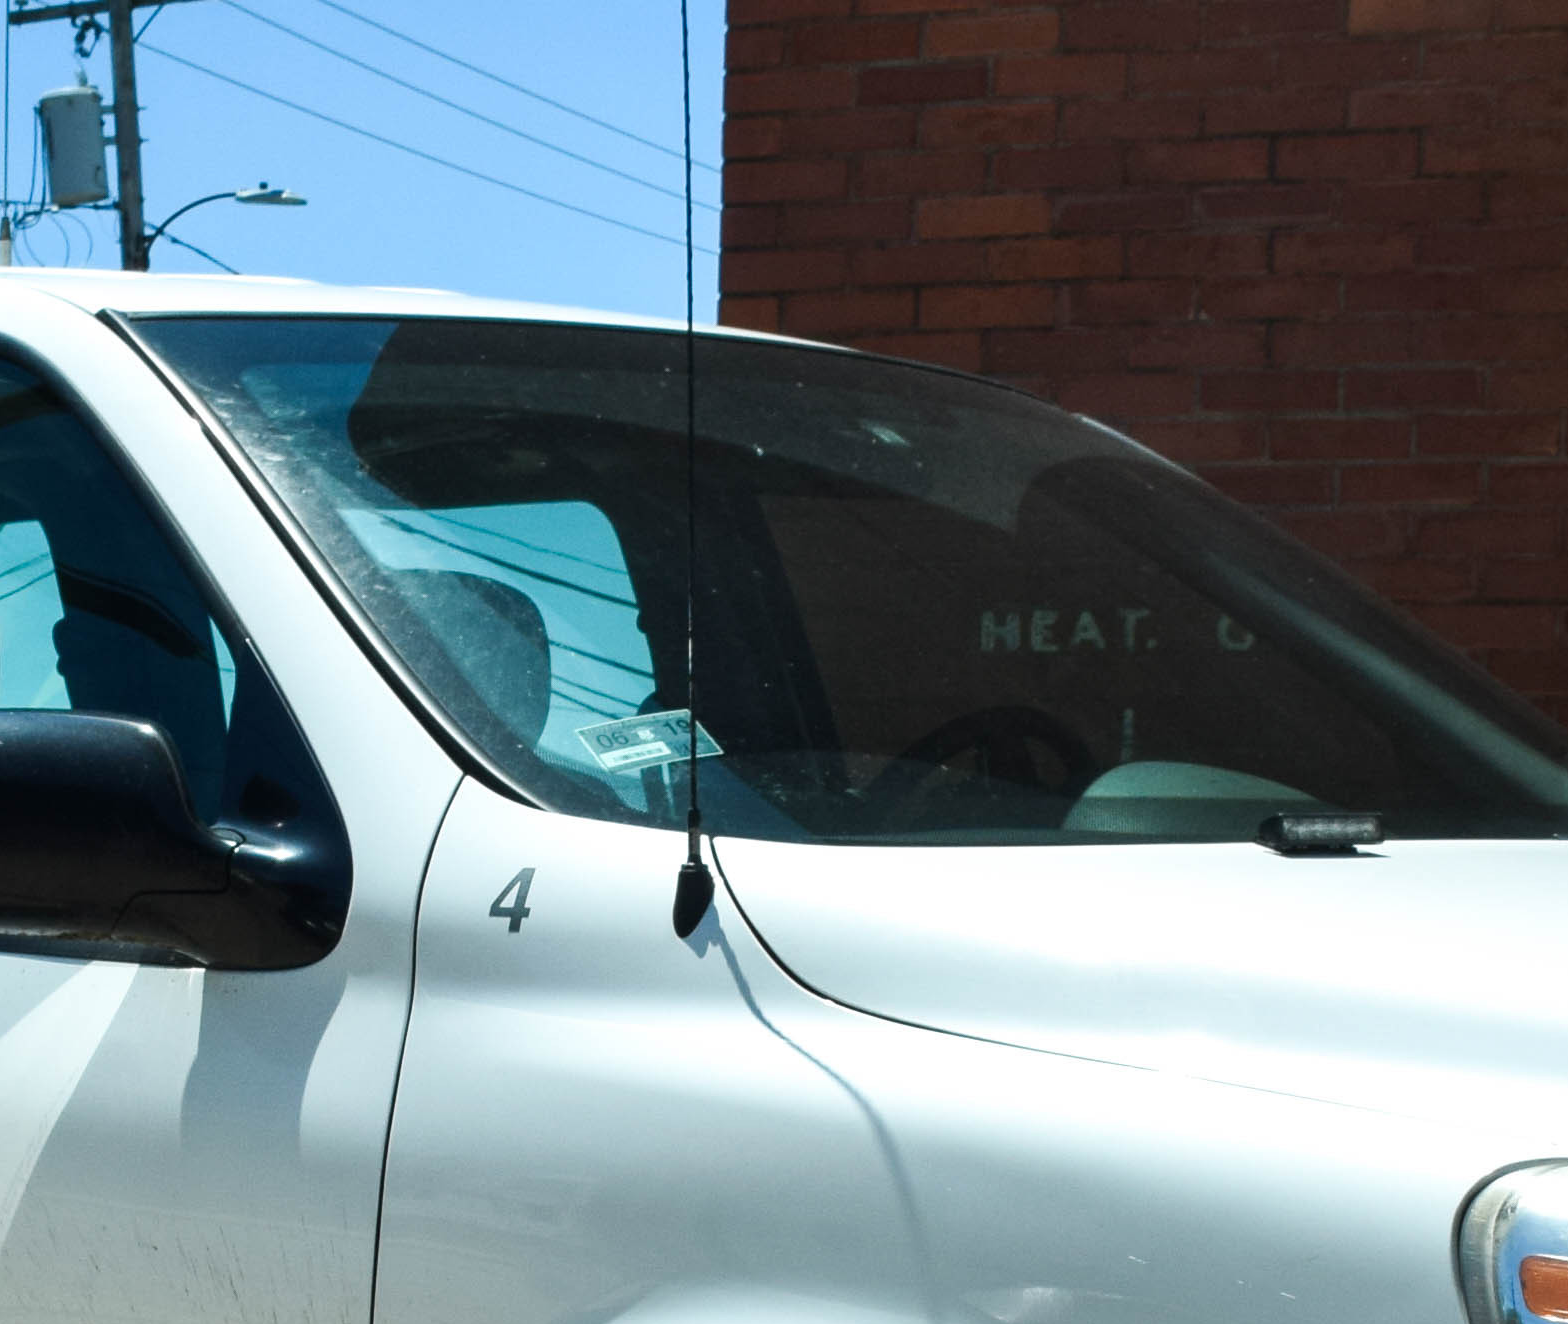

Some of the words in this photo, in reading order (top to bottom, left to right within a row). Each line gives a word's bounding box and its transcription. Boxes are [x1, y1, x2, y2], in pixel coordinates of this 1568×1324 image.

[980, 607, 1158, 652] HEAT.
[595, 730, 630, 749] 06
[488, 867, 536, 933] 4
